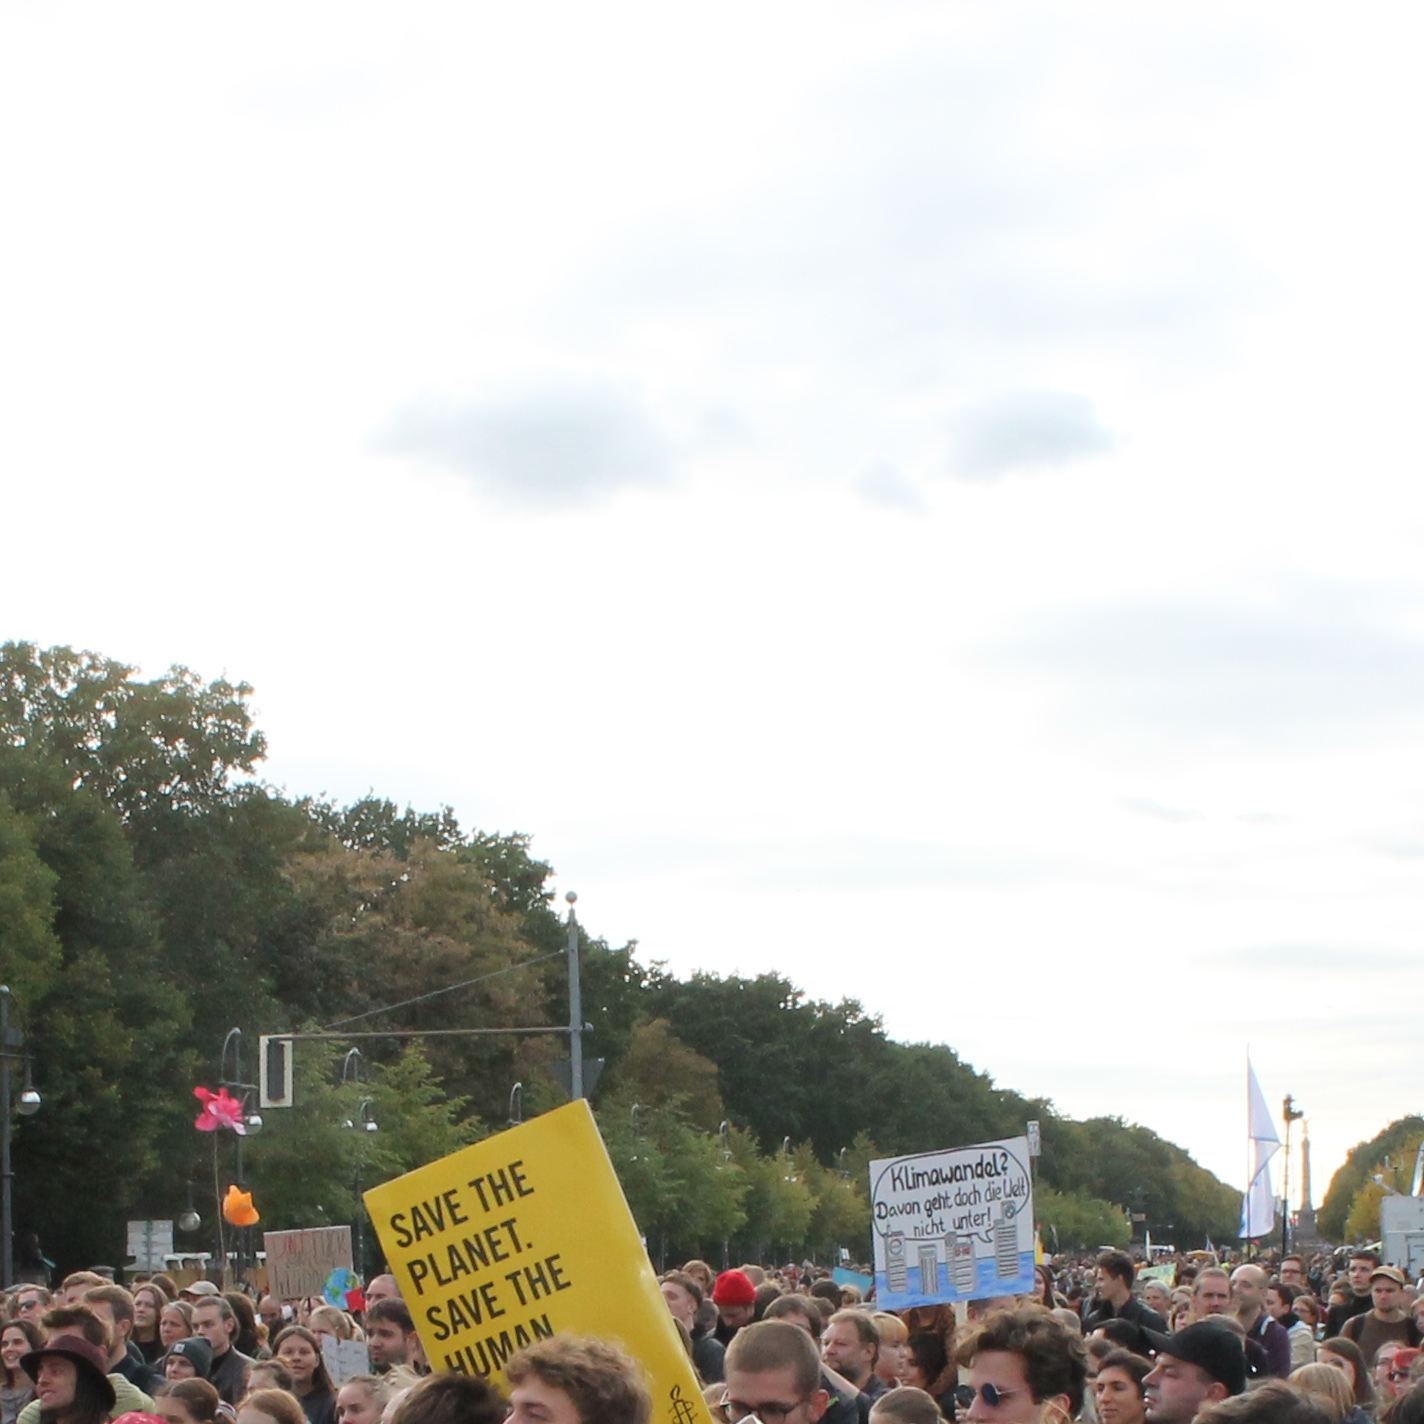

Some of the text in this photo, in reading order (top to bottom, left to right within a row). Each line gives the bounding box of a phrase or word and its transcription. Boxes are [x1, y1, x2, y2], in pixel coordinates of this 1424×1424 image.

[875, 1201, 921, 1220] Davon
[923, 1190, 953, 1218] geht
[954, 1186, 982, 1207] doch
[984, 1181, 1002, 1203] die
[891, 1152, 1009, 1193] Klimawandel?
[390, 1160, 535, 1248] SAVE THE
[913, 1207, 992, 1238] nicht unter!
[407, 1217, 533, 1296] PLANET.
[426, 1254, 572, 1341] SAVE THE
